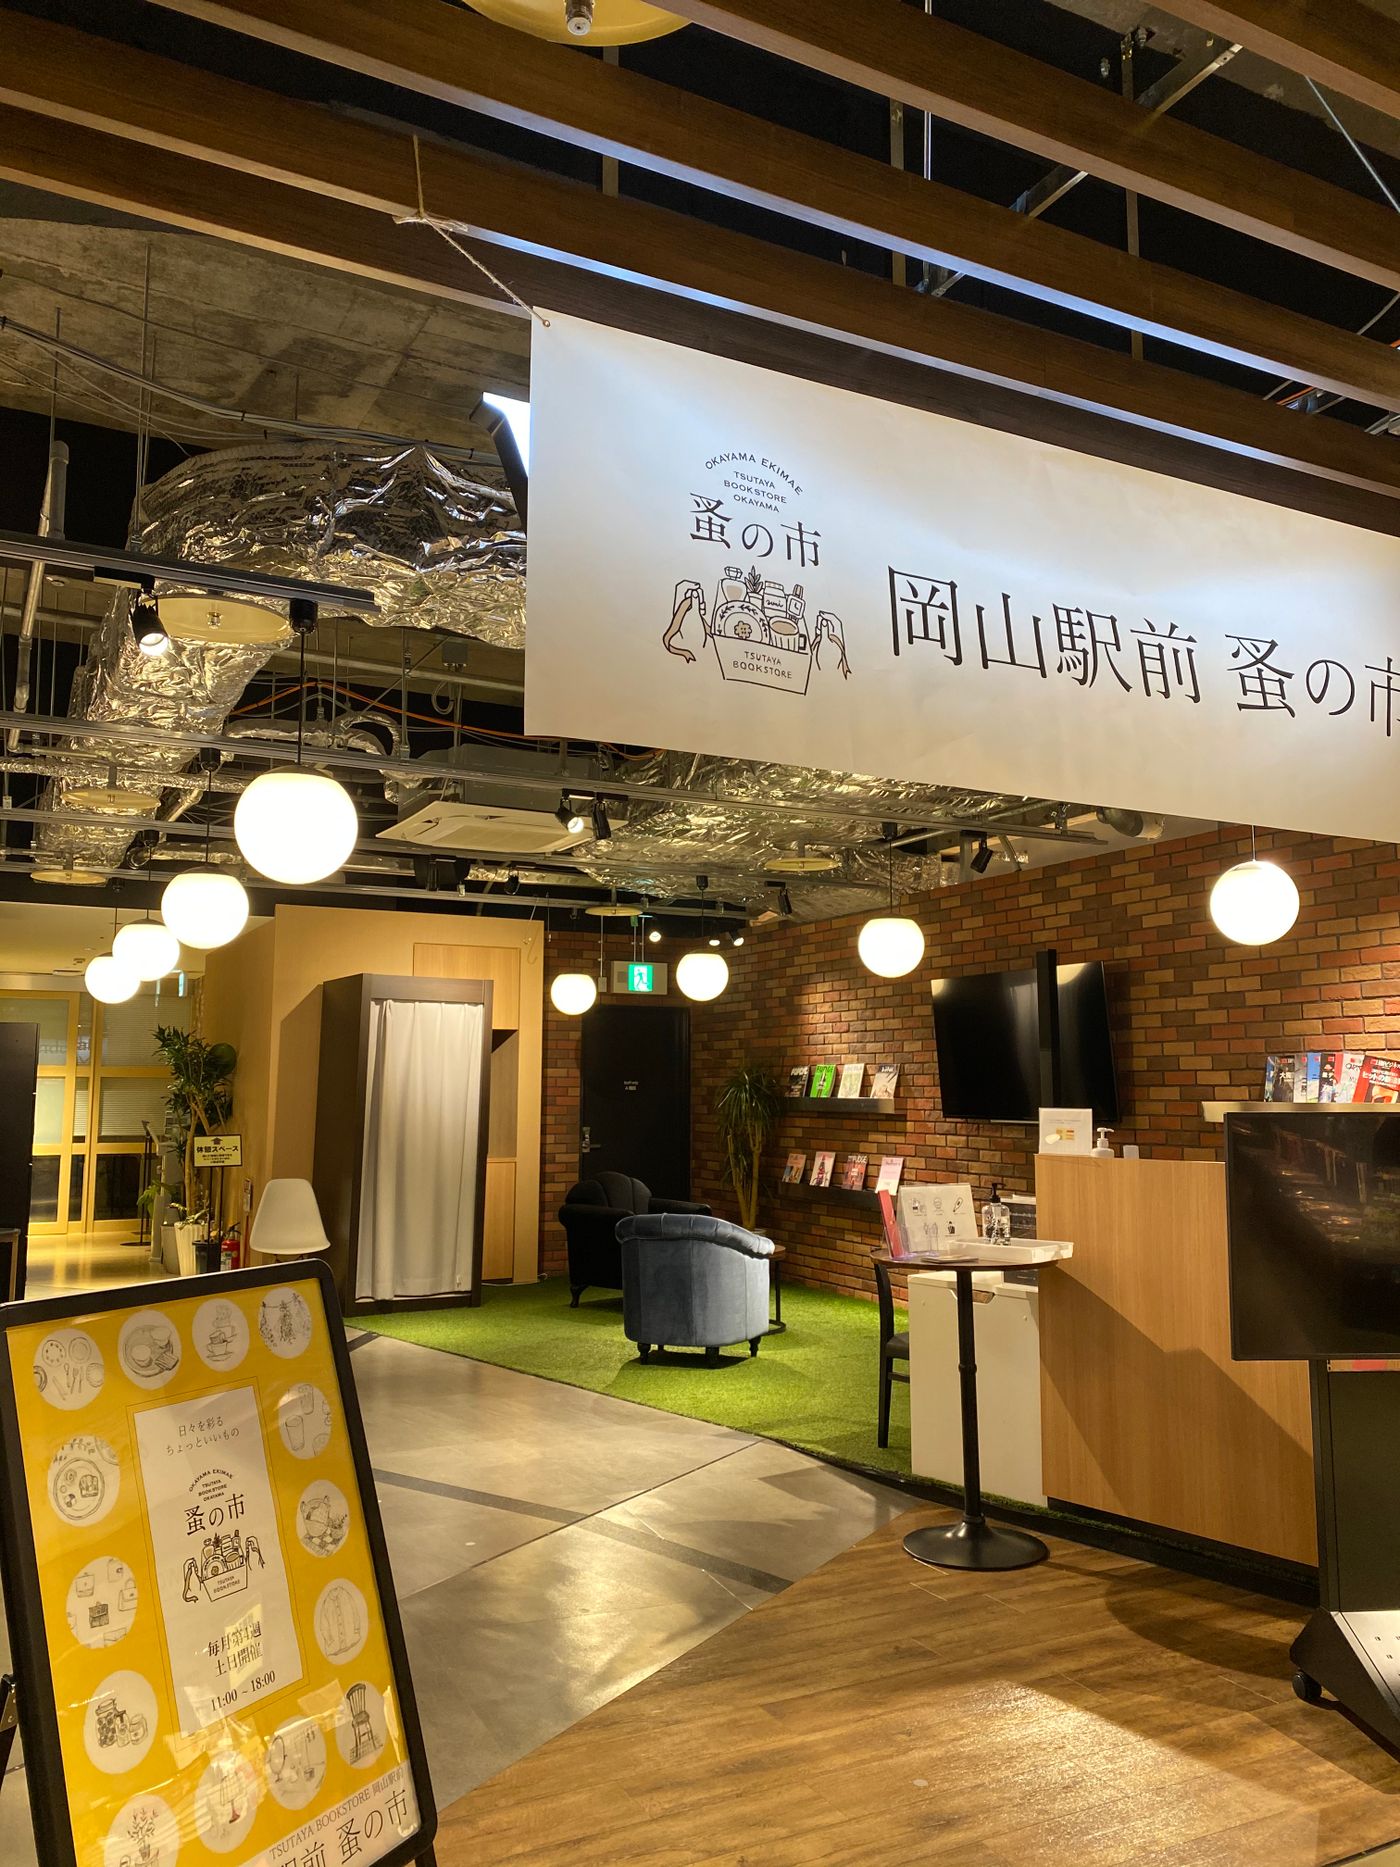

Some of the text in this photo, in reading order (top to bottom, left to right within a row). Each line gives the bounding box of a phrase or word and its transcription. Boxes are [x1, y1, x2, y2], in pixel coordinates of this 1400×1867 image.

[704, 451, 804, 496] OKAYAMA EKIMAE
[733, 470, 776, 490] TSUTAYA
[723, 479, 788, 504] BOOKSTORE
[733, 494, 780, 513] OKAYAMA
[689, 492, 822, 568] 蚤の市
[887, 564, 1201, 704] 岡山駅前
[732, 660, 793, 680] BOOKSTORE
[744, 650, 782, 666] TSUTAYA
[178, 1415, 224, 1438] 日々を彩る
[165, 1427, 240, 1457] ちょっといいもの
[188, 1468, 234, 1493] OKAYAMA EKIMAE
[198, 1483, 228, 1498] BOOKSTORE
[184, 1493, 245, 1537] 蚤の市
[215, 1642, 264, 1678] 土日開催
[210, 1688, 239, 1712] 11:00
[251, 1669, 277, 1693] 18:00
[268, 1825, 315, 1861] TSUTAYA
[315, 1787, 371, 1833] BOOKSTORE
[335, 1788, 407, 1865] 蚤の市
